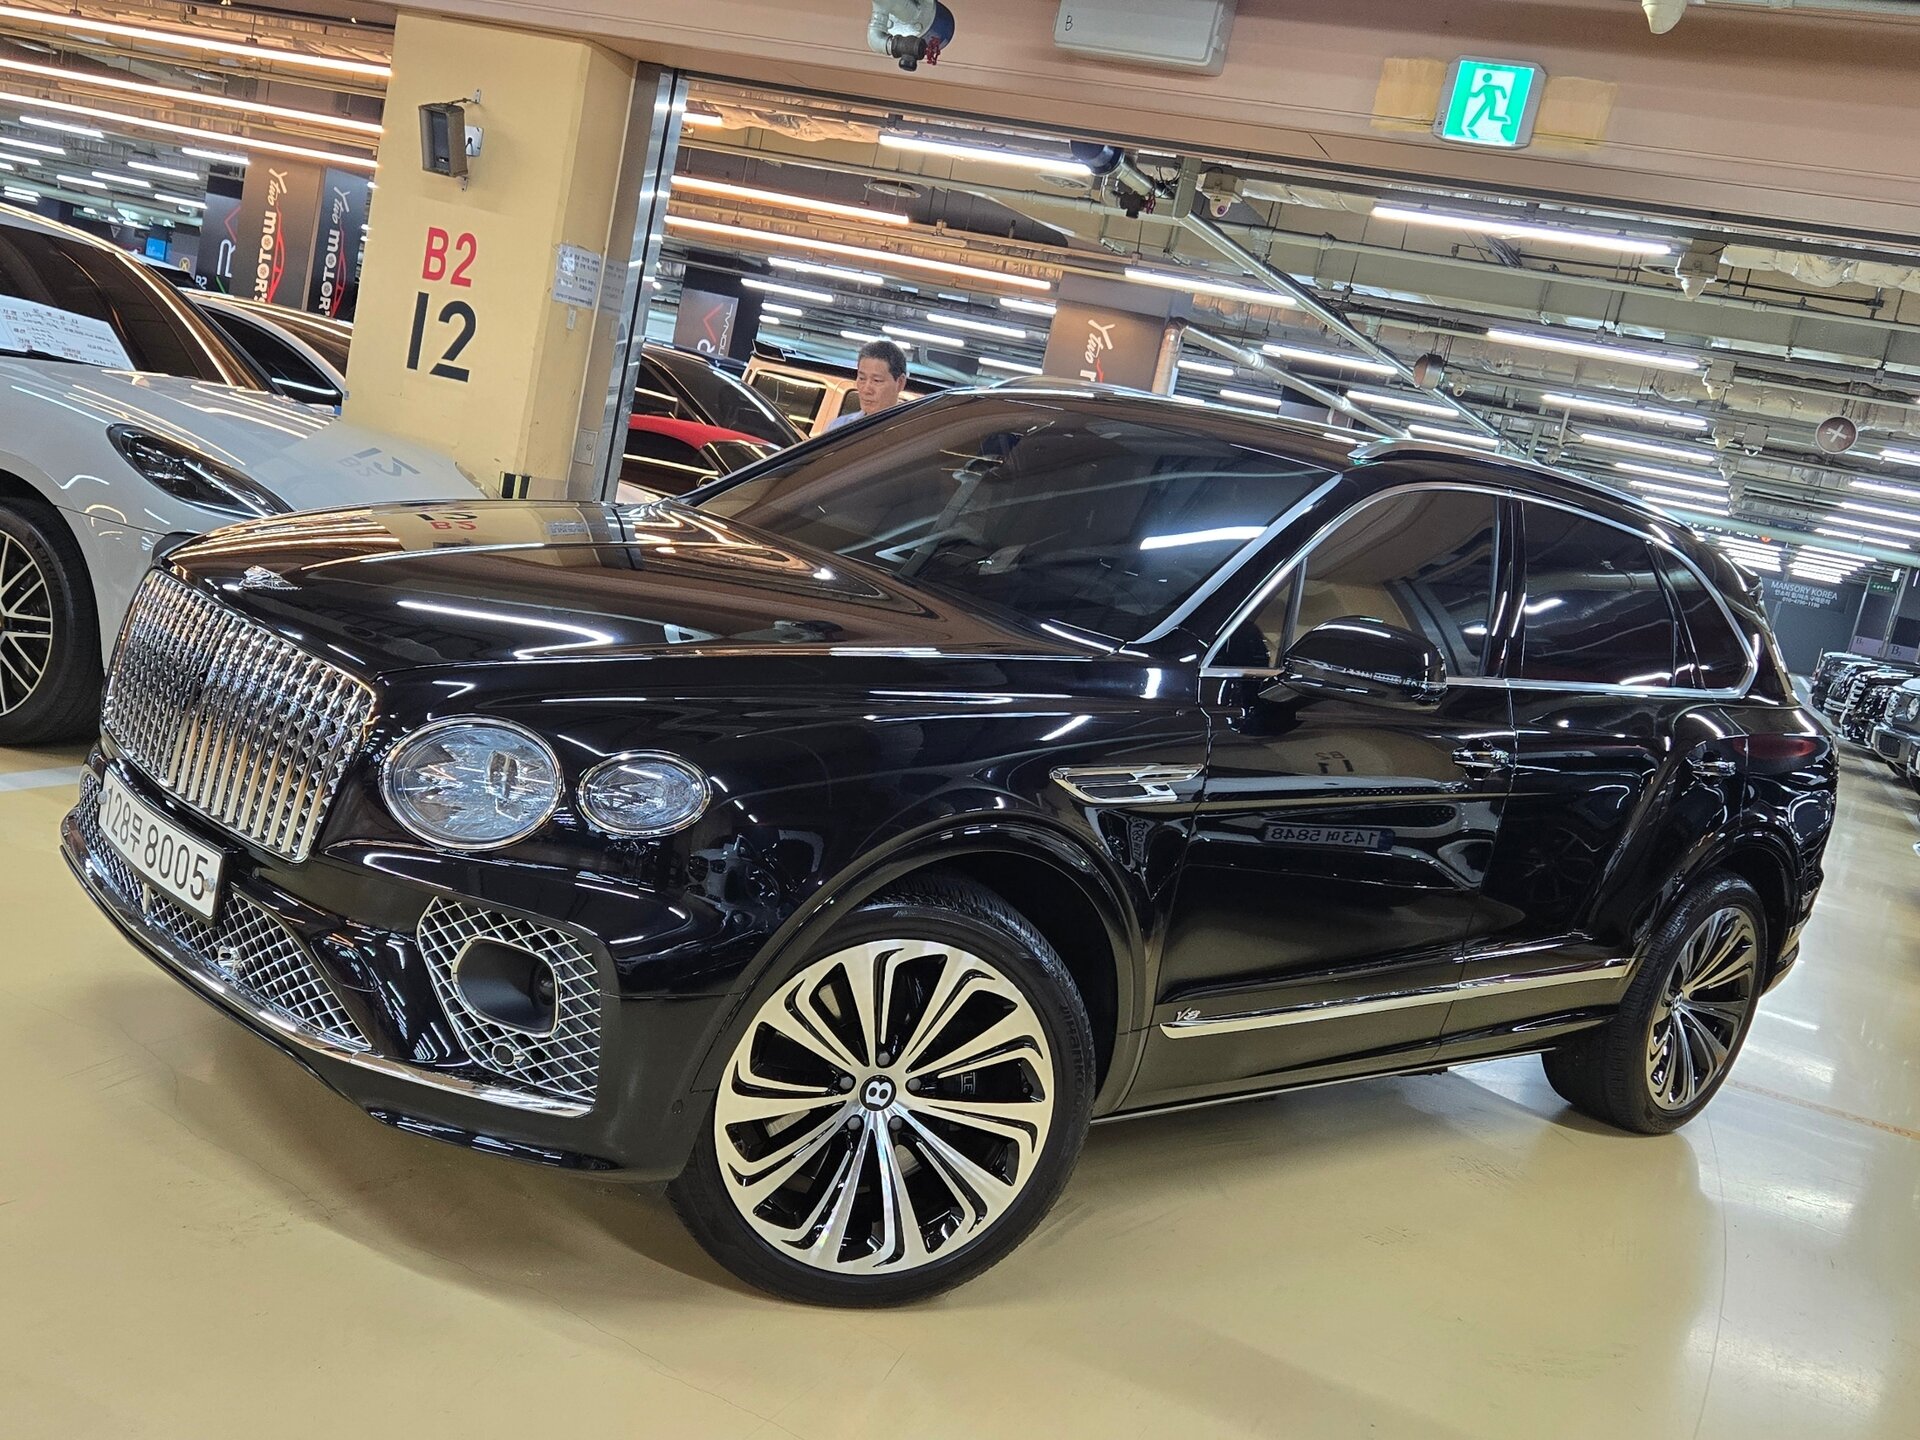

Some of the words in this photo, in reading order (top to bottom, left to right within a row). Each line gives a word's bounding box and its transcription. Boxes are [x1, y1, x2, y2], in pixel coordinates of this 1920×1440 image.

[1065, 15, 1073, 31] B
[422, 226, 478, 288] B2
[406, 291, 477, 383] 12
[1085, 319, 1116, 364] Ytwo
[1770, 581, 1811, 594] MANSORY
[1811, 588, 1838, 600] KOREA
[105, 784, 143, 853] 128무
[144, 824, 209, 901] 8005
[865, 1080, 893, 1107] B
